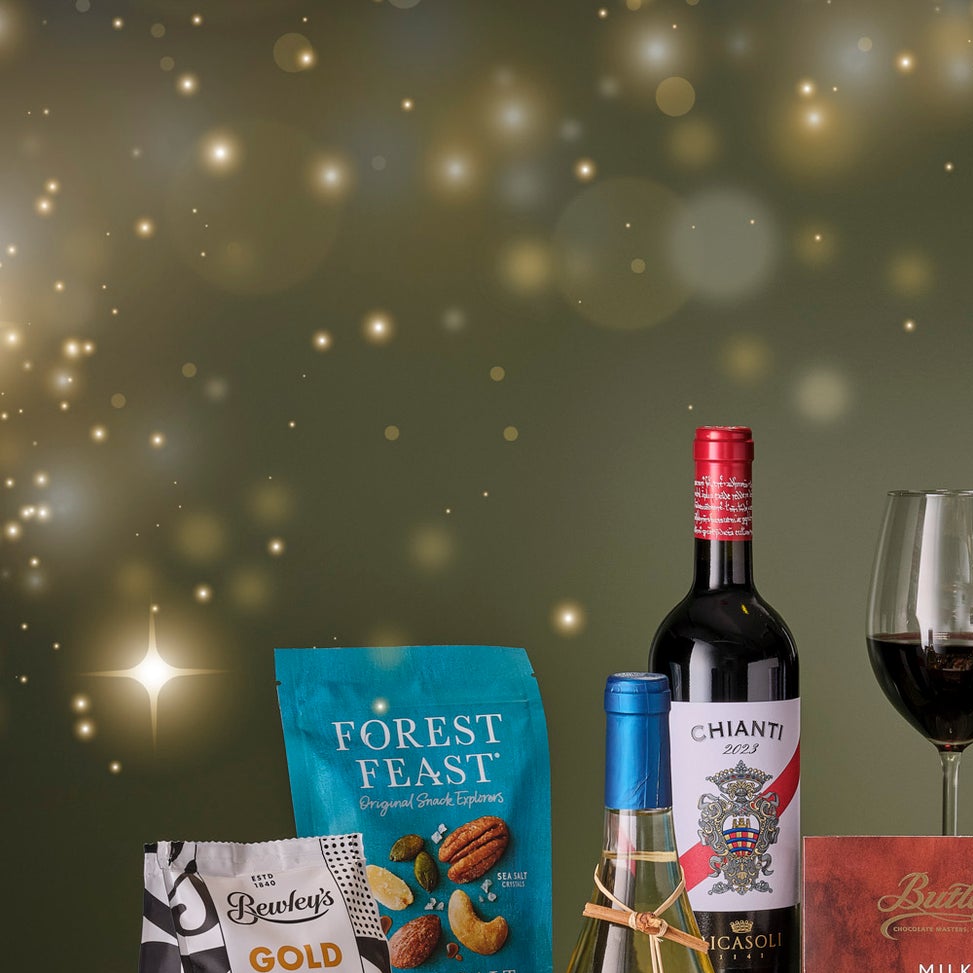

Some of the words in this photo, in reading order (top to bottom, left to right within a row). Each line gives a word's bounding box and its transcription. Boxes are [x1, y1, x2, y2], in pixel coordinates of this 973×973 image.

[332, 714, 502, 750] FOREST
[691, 720, 783, 742] CHIANTI
[723, 743, 759, 754] 2023
[355, 753, 493, 789] FEAST
[360, 794, 414, 817] Original
[416, 792, 453, 807] Snack
[455, 791, 504, 808] Explorers
[251, 873, 273, 882] ESTD
[254, 880, 276, 888] 1840
[497, 872, 511, 880] SEA
[513, 872, 527, 880] SALT
[227, 888, 334, 925] Bewley's
[702, 933, 781, 950] ICASOLI
[249, 942, 342, 972] GOLD
